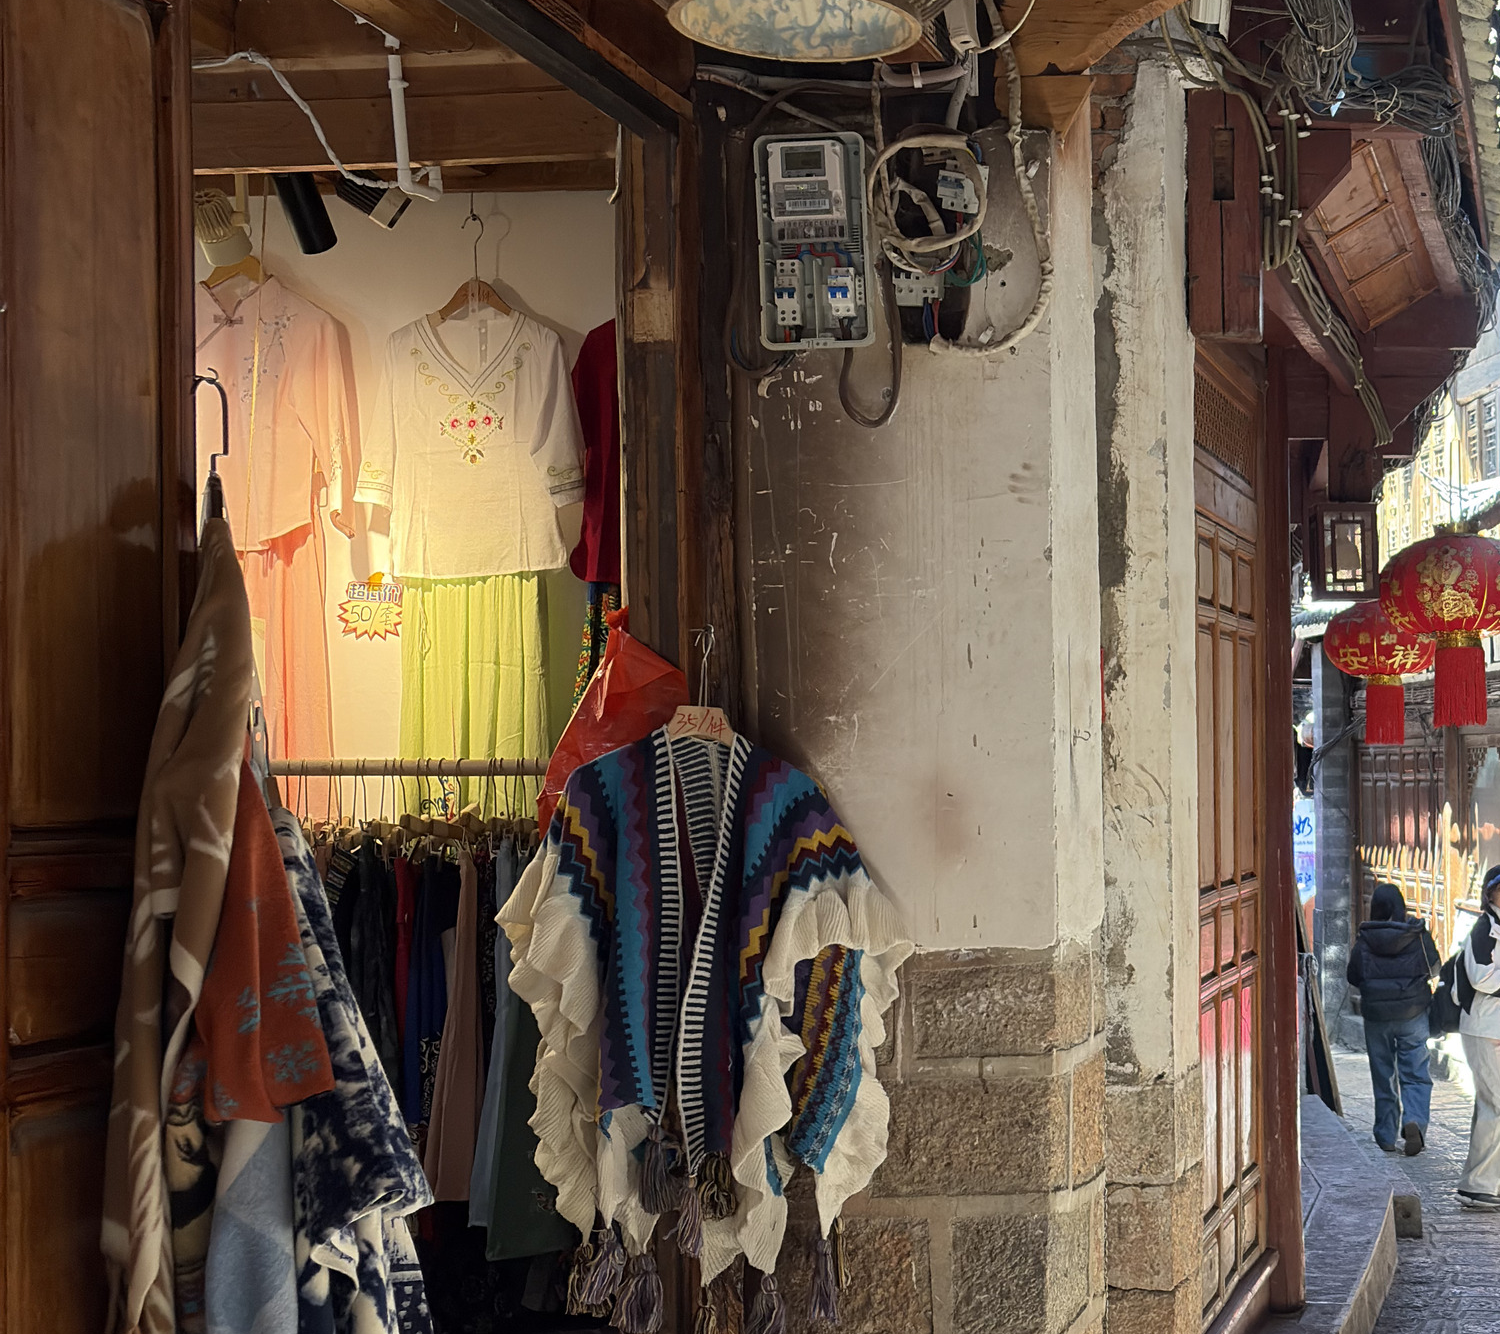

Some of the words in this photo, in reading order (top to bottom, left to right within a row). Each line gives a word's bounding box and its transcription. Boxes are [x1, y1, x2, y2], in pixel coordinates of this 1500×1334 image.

[348, 583, 399, 602] 超低价
[348, 603, 395, 633] 50/套
[673, 708, 727, 739] 35/件
